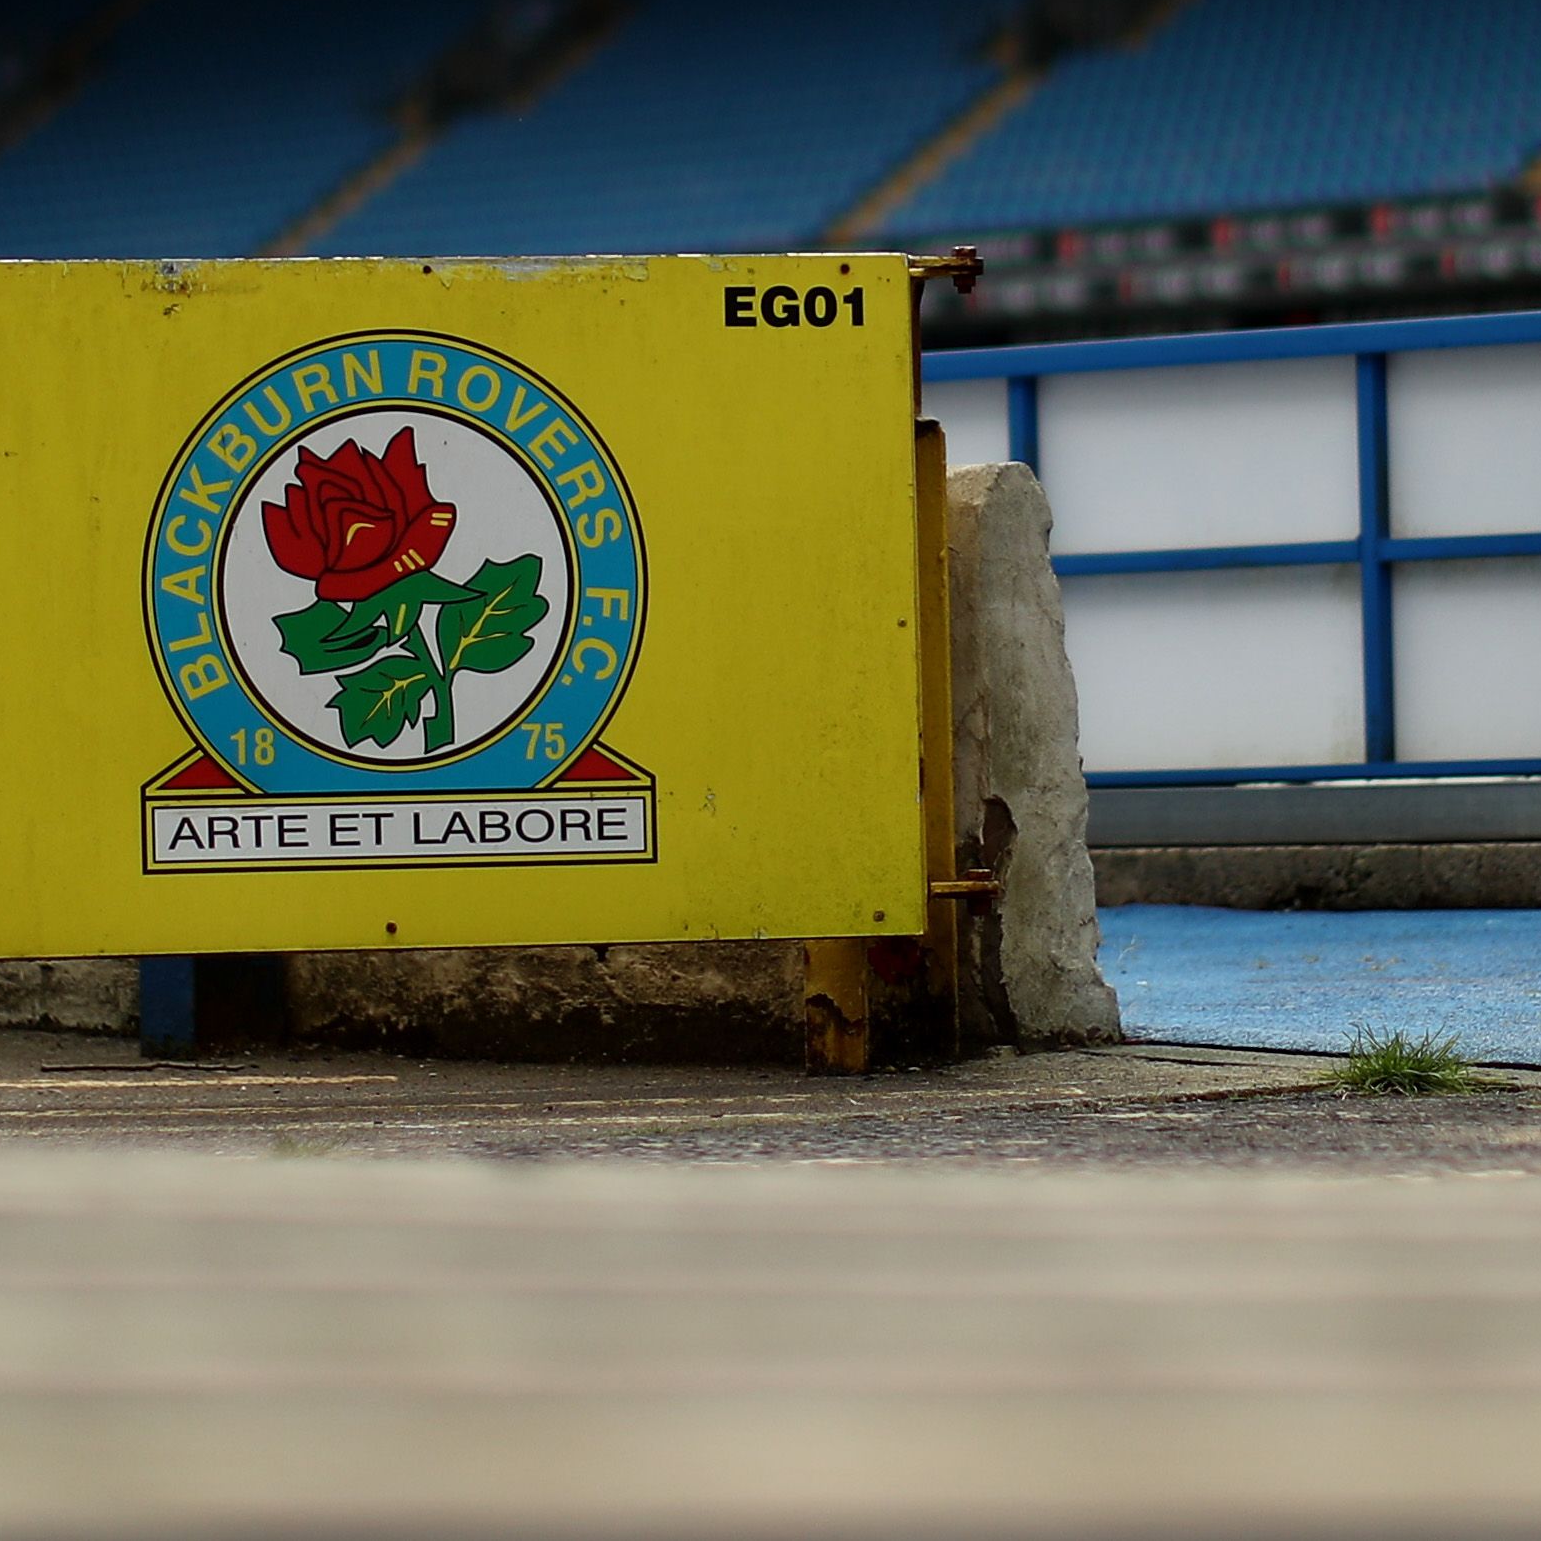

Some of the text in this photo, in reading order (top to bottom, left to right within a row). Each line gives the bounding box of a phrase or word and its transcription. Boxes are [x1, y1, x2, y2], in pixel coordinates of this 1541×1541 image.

[723, 286, 866, 328] EG01
[160, 347, 630, 700] BLACKBURN ROVERS F.C.
[230, 723, 566, 766] 18 75
[169, 807, 629, 851] ARTE ET LABORE
